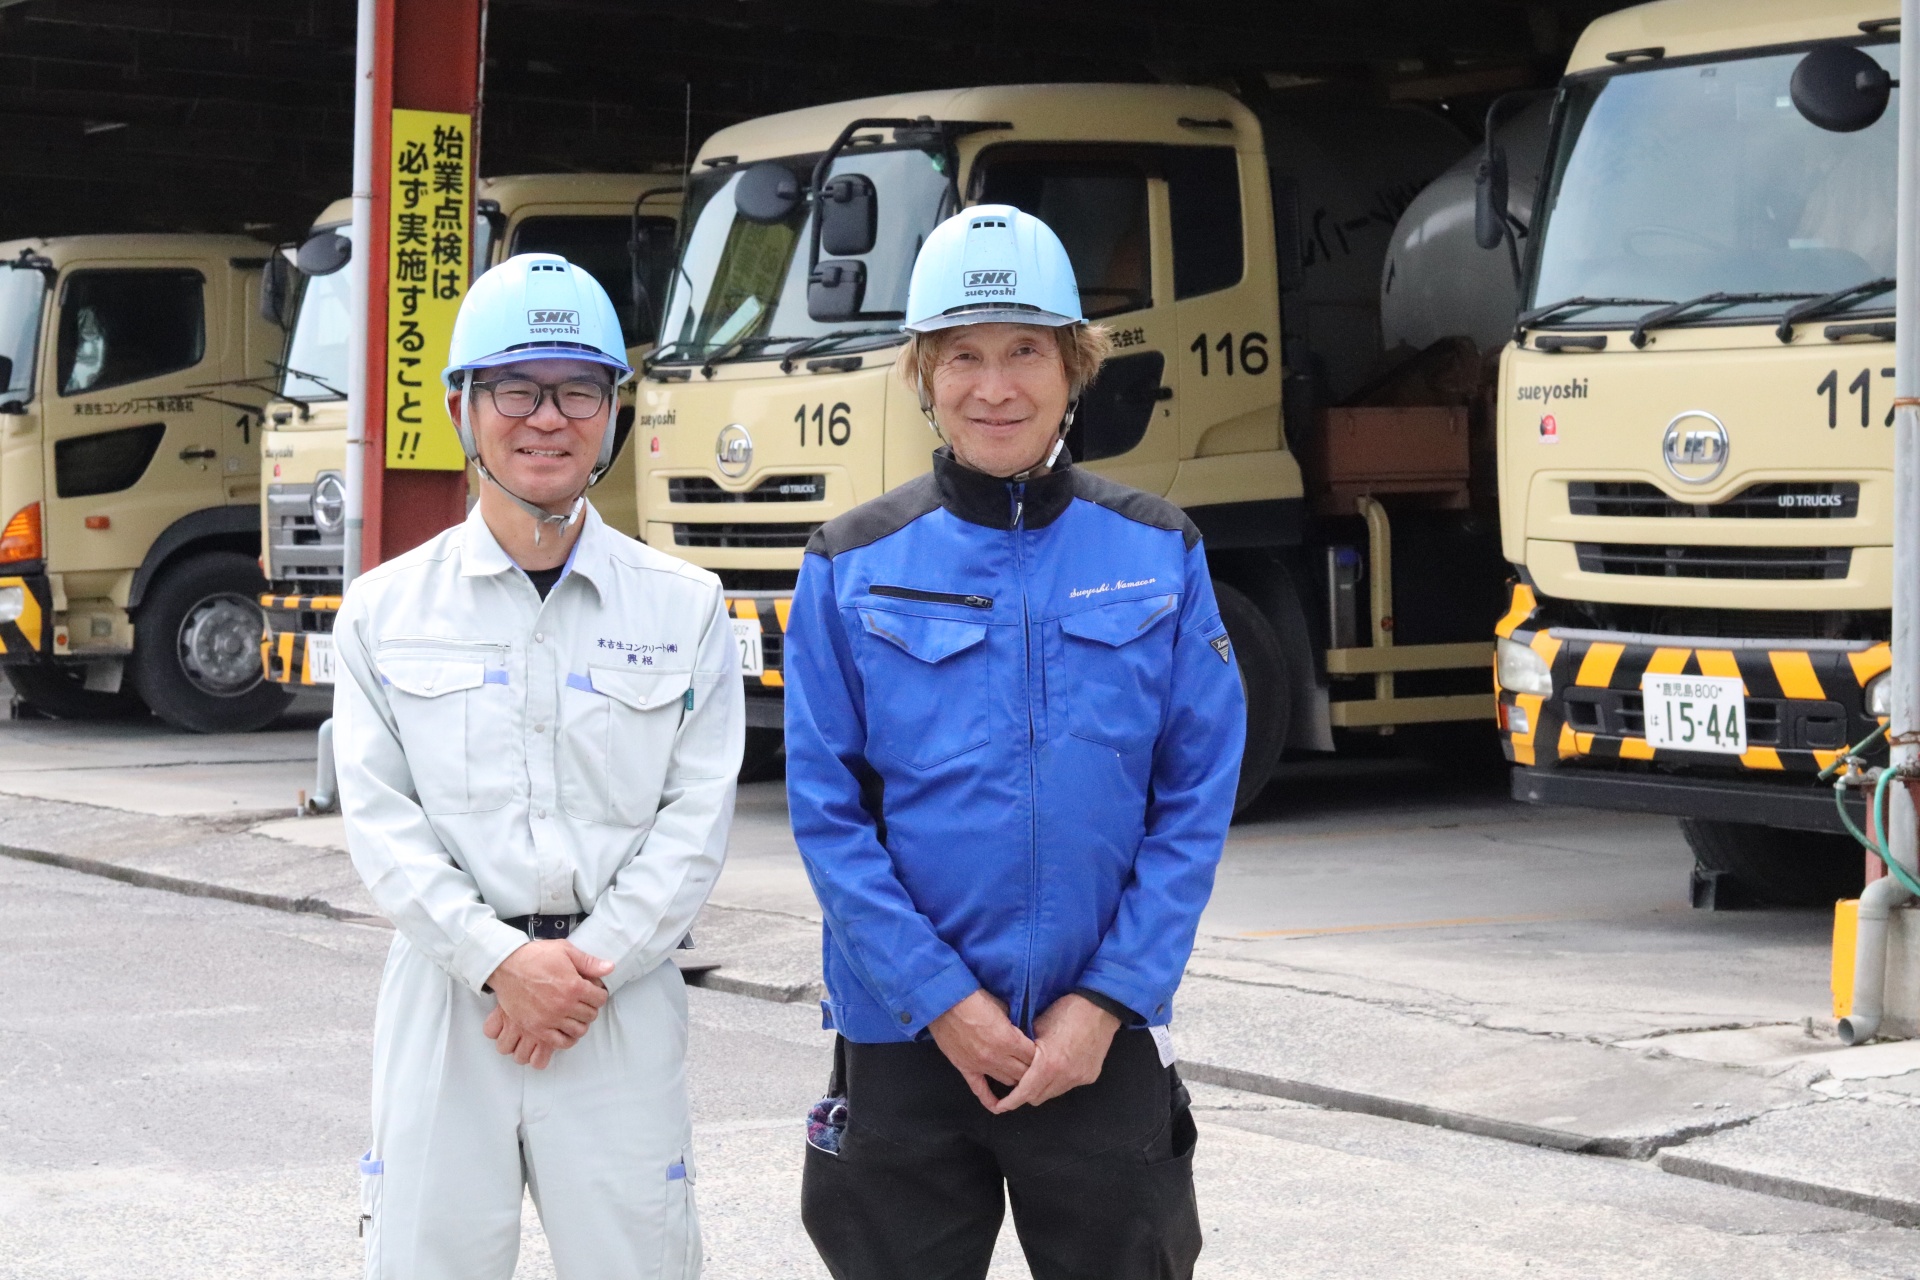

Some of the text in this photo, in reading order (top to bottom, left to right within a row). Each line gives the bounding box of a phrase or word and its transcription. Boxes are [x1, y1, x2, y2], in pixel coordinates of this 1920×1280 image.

[432, 125, 464, 300] 始業点検は
[969, 272, 1012, 285] SNK
[964, 287, 1017, 298] sueyoshi
[533, 311, 575, 323] SNK
[529, 325, 580, 336] sueyoshi
[1190, 331, 1269, 377] 116
[1517, 377, 1589, 405] sueyoshi
[640, 409, 676, 429] sueyoshi
[794, 402, 851, 447] 116
[790, 484, 816, 494] TRUCKS
[1778, 494, 1842, 507] UD TRUCKS
[1069, 583, 1109, 598] Sueyoshi
[1650, 714, 1659, 727] は
